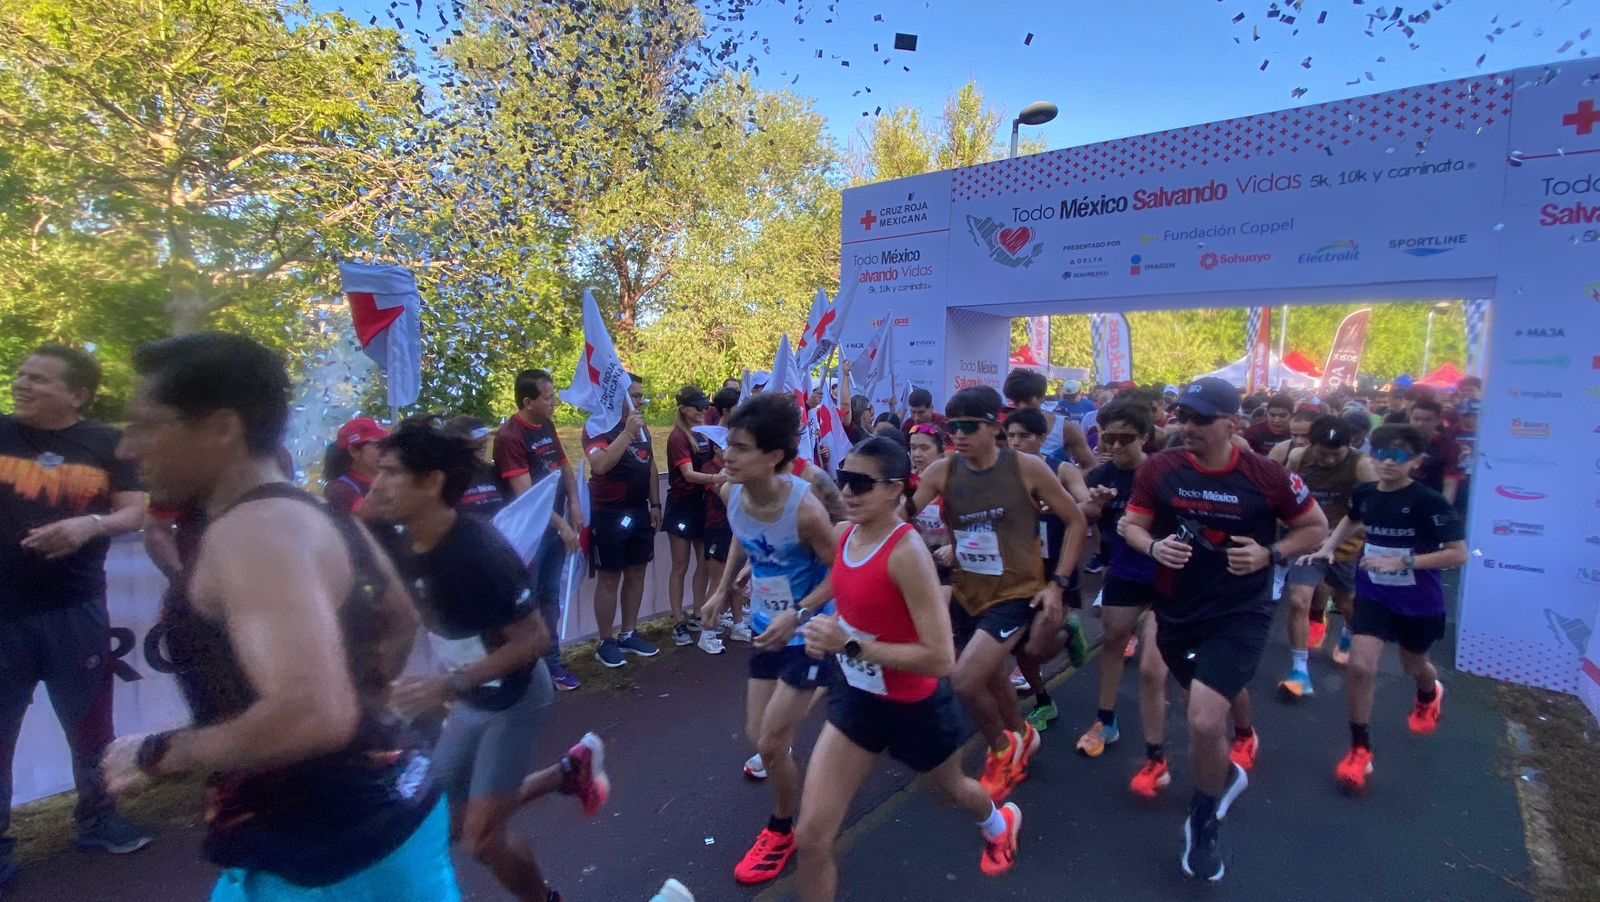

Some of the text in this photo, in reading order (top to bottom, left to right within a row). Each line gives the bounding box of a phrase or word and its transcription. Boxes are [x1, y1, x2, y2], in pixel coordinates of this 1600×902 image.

[1012, 204, 1055, 222] Todo
[1060, 194, 1128, 220] México
[1132, 178, 1229, 211] Salvando
[1235, 172, 1302, 196] Vidas
[1310, 174, 1332, 189] 5k,
[1338, 169, 1367, 185] 10k
[1372, 170, 1384, 184] y
[880, 202, 928, 217] CRUZ ROJA
[880, 212, 928, 227] MEXICANA
[1163, 218, 1294, 242] Fundación Coppel
[1063, 240, 1121, 251] PRESENTADO POR
[1389, 234, 1468, 249] SPORTLINE
[853, 248, 921, 266] Todo México
[1077, 256, 1103, 264] DELTA
[1219, 252, 1272, 265] Sahuayo
[1298, 250, 1360, 264] Electrolit
[859, 265, 934, 283] alvando Vidas
